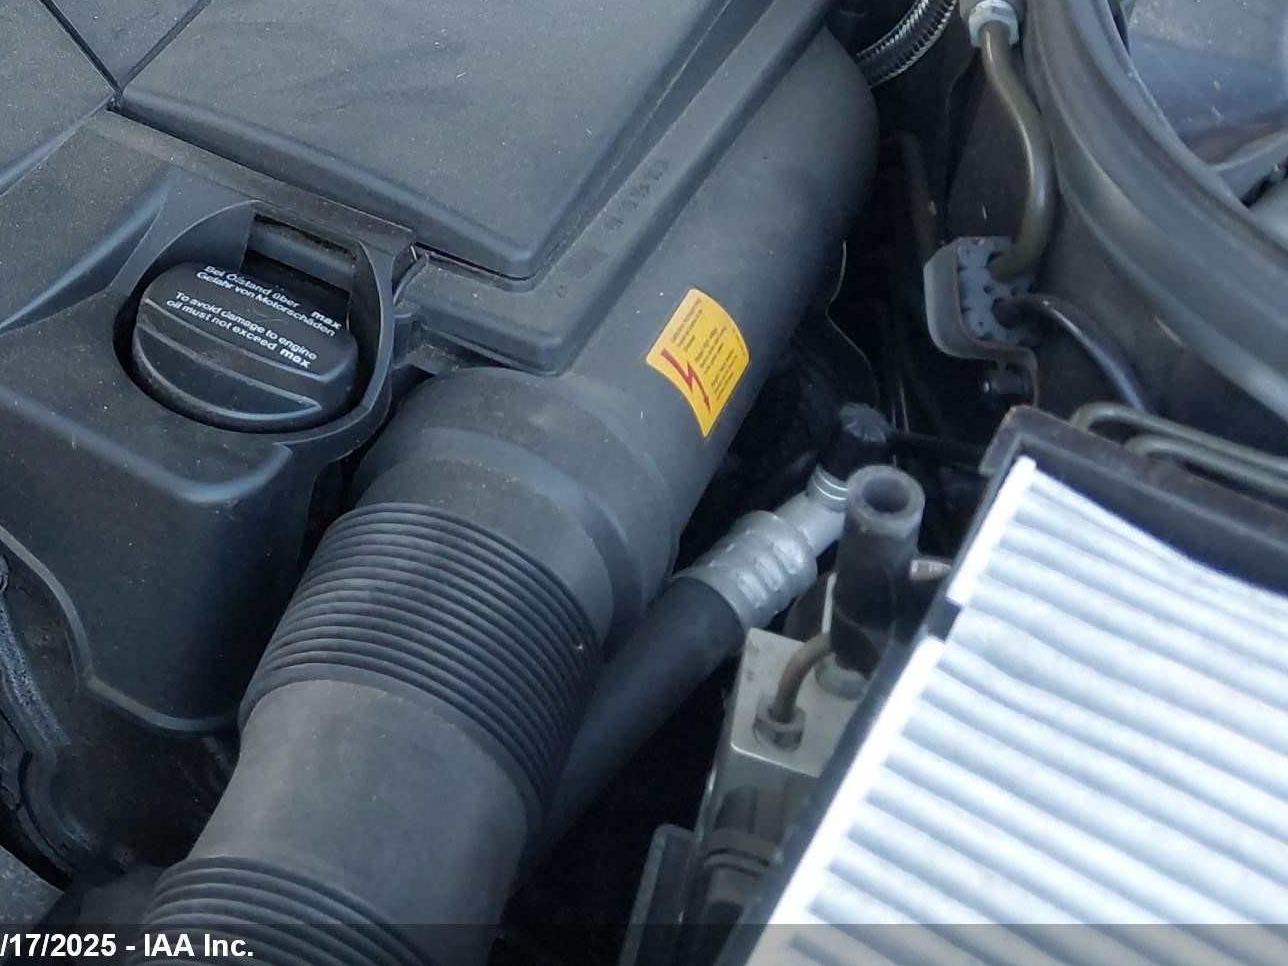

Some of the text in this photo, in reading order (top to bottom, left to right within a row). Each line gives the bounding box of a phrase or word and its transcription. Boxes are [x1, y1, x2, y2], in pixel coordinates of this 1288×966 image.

[176, 291, 317, 361] To avoid damage to engine
[197, 271, 335, 337] Gefahr von Motorschäden
[204, 265, 225, 277] Bei
[272, 291, 300, 308] über
[311, 311, 342, 329] max
[166, 300, 310, 368] oil must not exceed max
